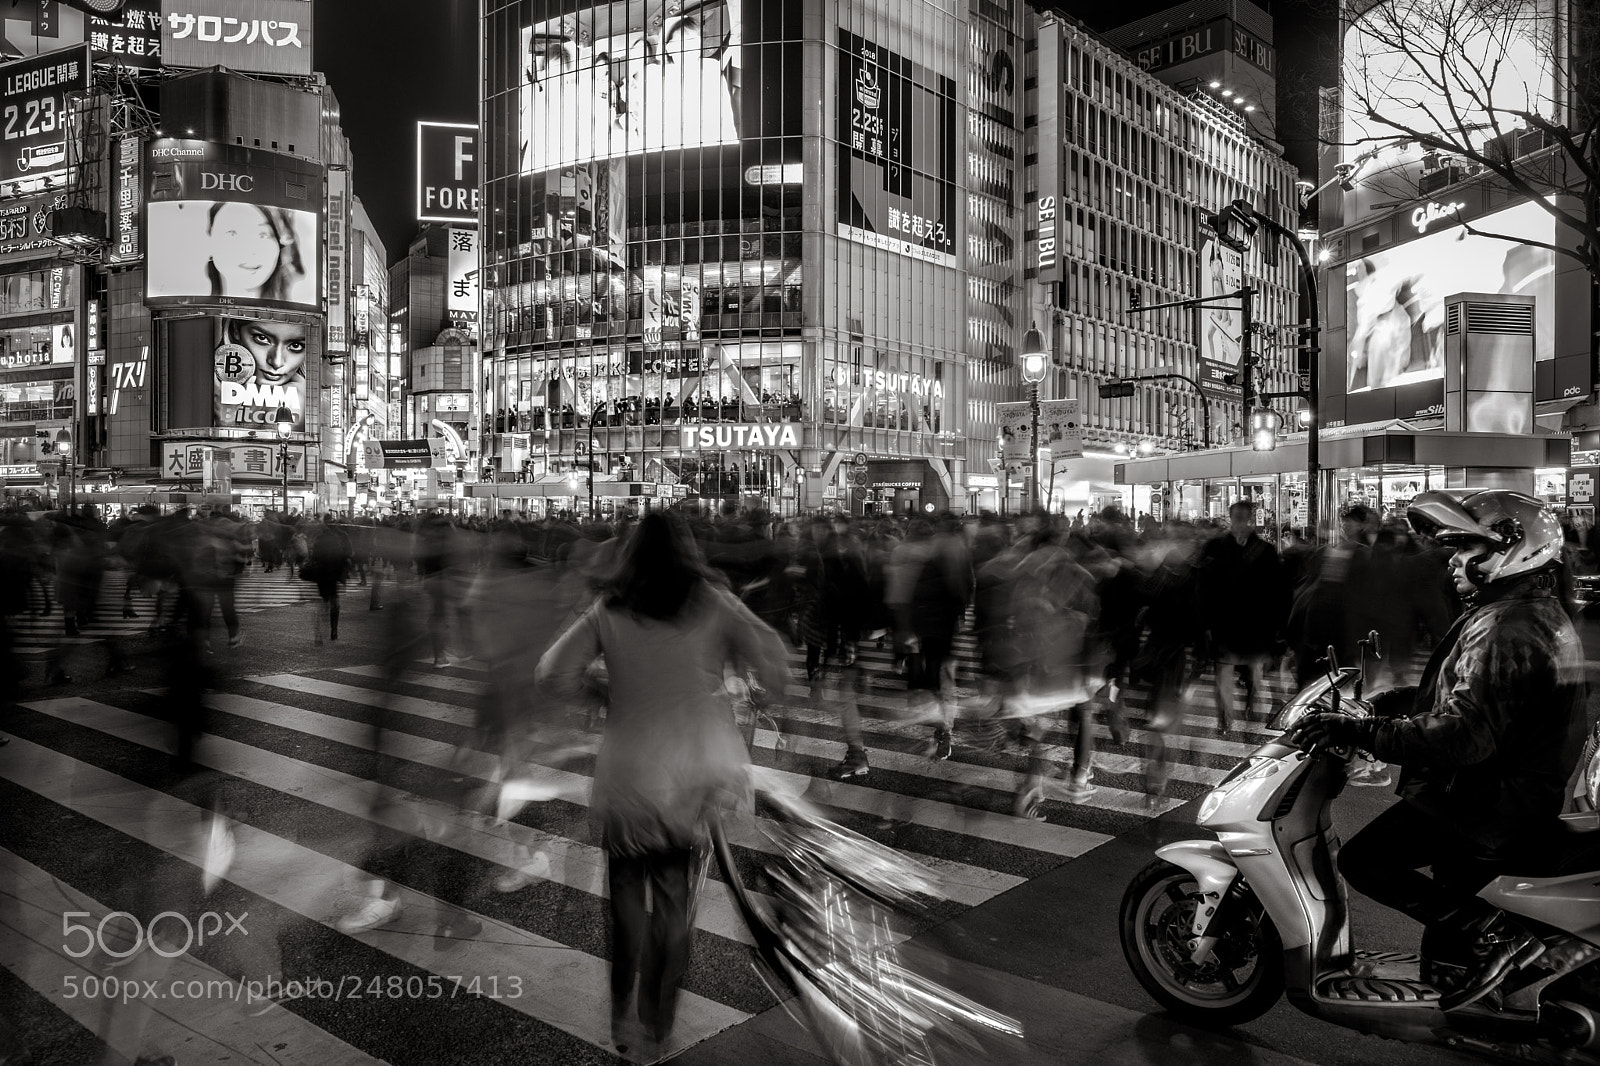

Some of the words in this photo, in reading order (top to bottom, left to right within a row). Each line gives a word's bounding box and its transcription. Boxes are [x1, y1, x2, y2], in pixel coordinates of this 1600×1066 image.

[168, 12, 302, 48] サロンパス
[1138, 28, 1213, 72] SEIBU
[1235, 29, 1272, 72] SEIBU
[4, 96, 56, 141] 2.23
[853, 108, 880, 136] 2.23
[152, 148, 169, 157] DHC
[170, 147, 203, 156] Channel
[201, 172, 254, 193] DHC
[1038, 195, 1056, 269] SEIBU
[1411, 202, 1466, 233] Glico
[452, 231, 474, 253] 落
[329, 255, 341, 307] neon
[453, 279, 470, 298] ま
[219, 297, 235, 305] DHC
[220, 380, 301, 409] DMM
[863, 368, 945, 399] TSUTAYA
[1563, 386, 1581, 397] pdc
[683, 425, 798, 447] TSUTAYA
